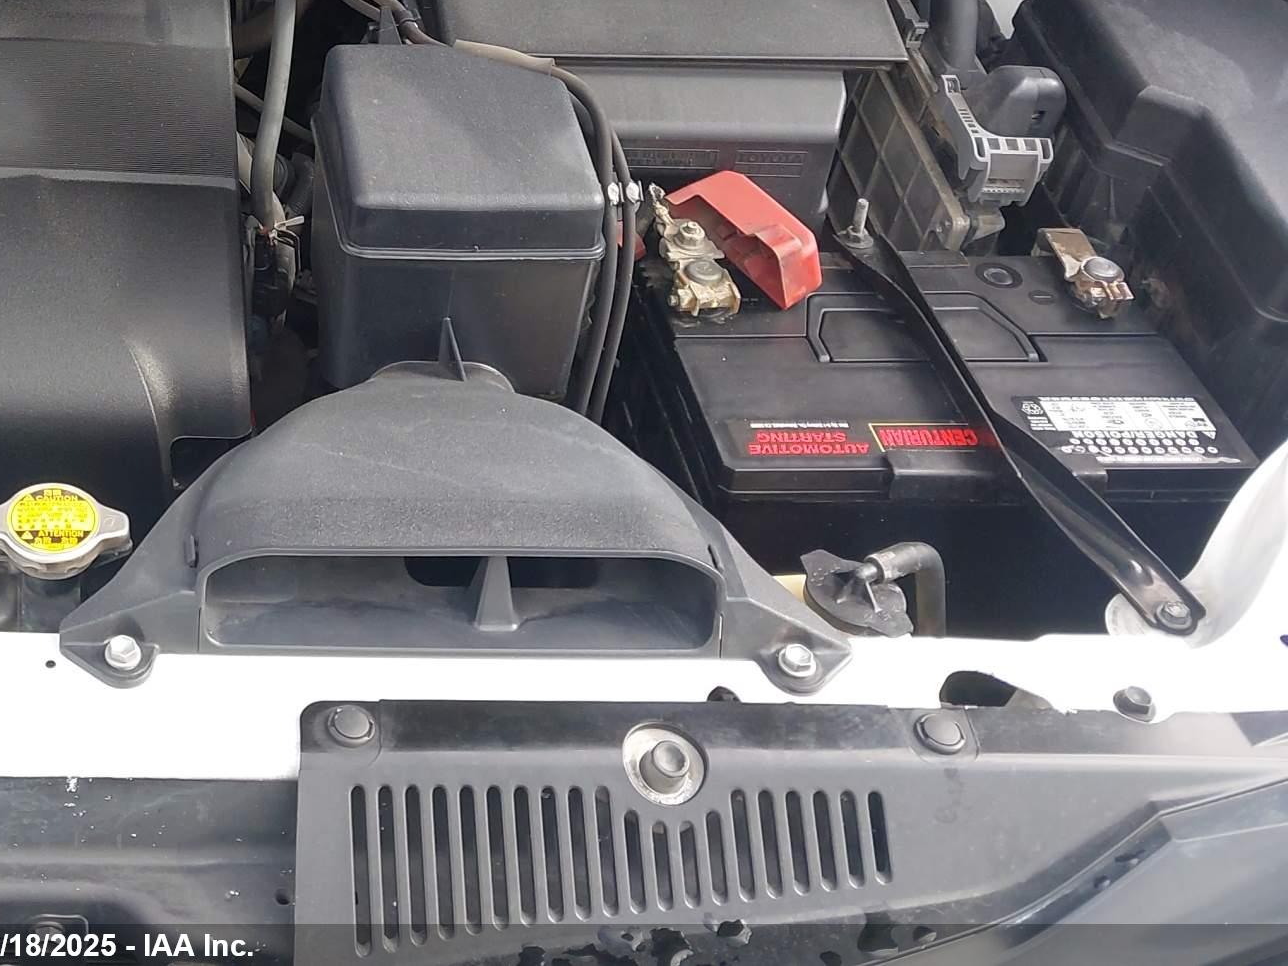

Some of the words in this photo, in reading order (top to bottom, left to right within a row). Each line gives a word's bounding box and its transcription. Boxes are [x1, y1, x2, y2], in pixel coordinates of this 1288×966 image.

[756, 432, 847, 443] STARTING
[879, 428, 978, 447] CENTURIAN
[1072, 430, 1199, 438] DANGER/POISON
[748, 443, 870, 455] AUTOMOTIVE
